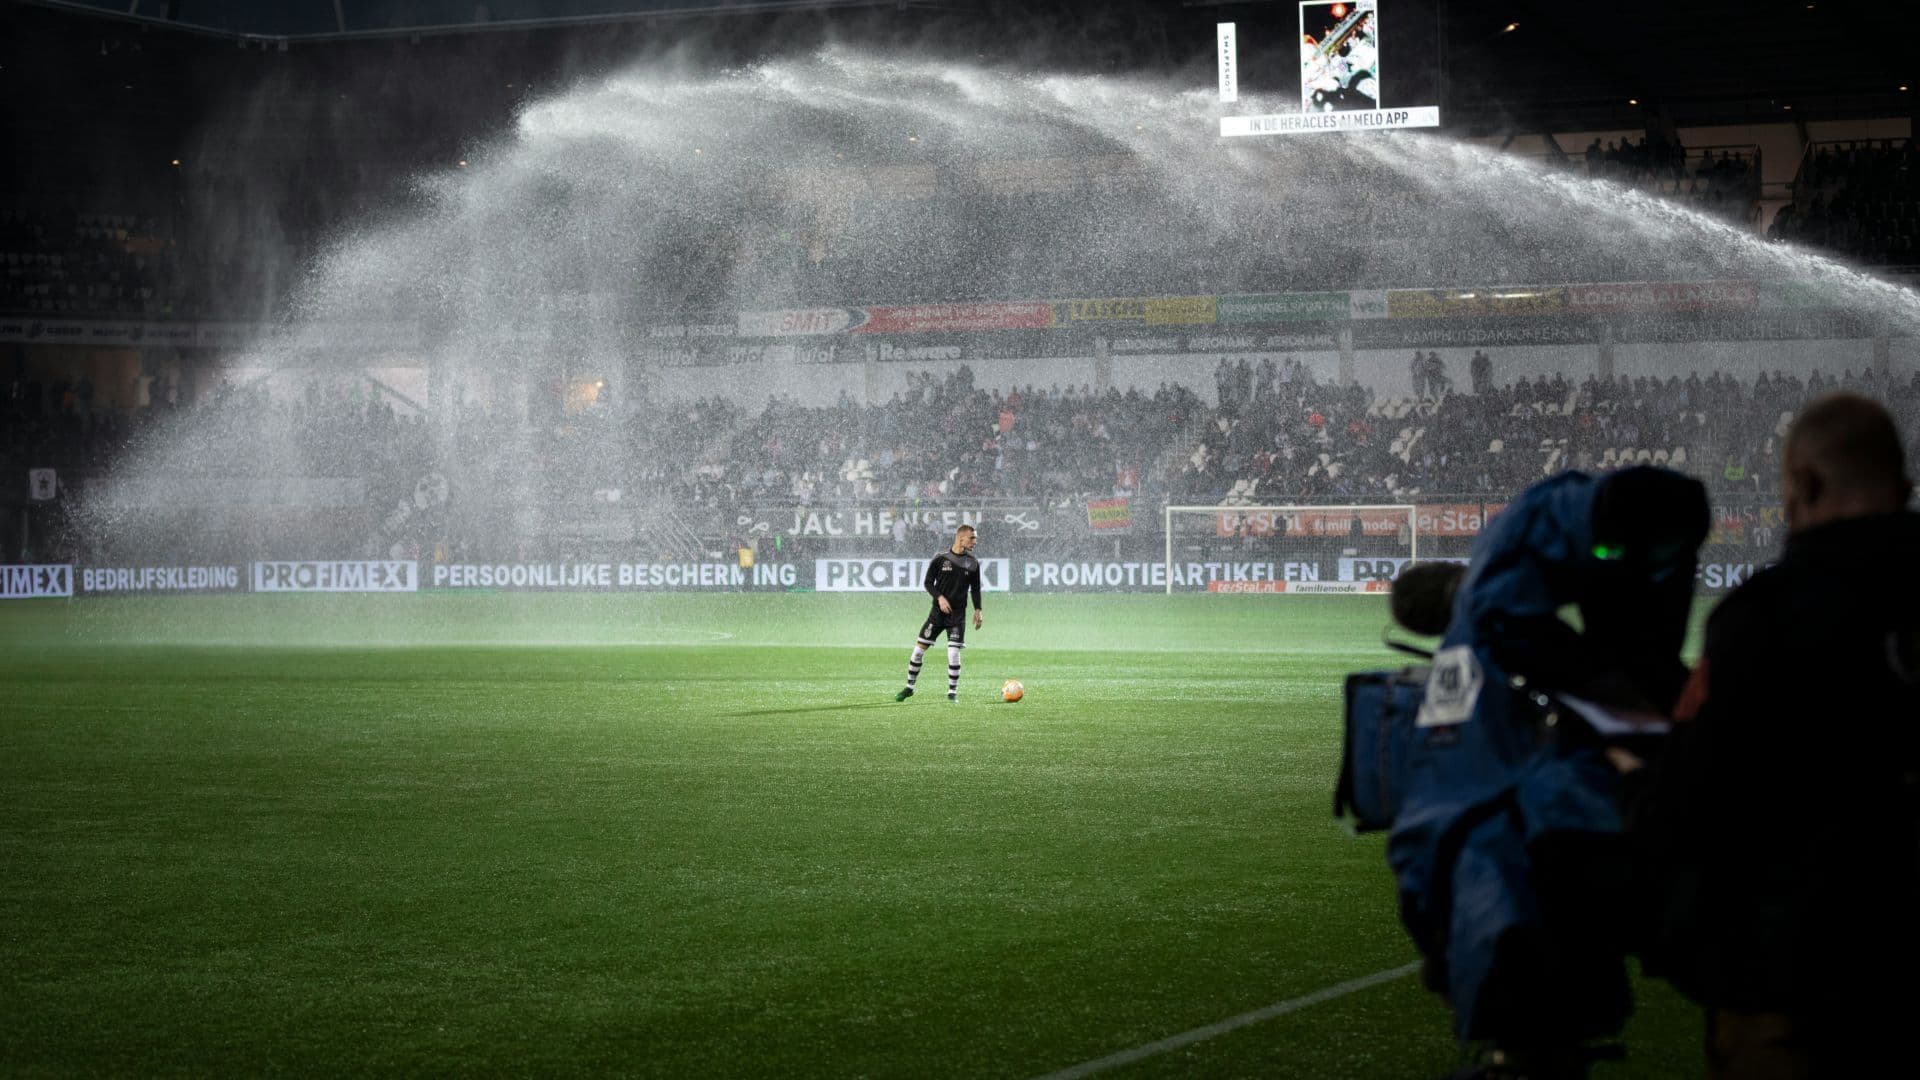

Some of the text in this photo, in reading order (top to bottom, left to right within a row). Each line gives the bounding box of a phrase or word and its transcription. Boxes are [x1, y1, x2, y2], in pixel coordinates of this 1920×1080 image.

[1250, 119, 1262, 131] IN
[1264, 118, 1277, 130] DE
[1280, 115, 1337, 130] HERACLES
[1385, 111, 1409, 125] APP
[786, 512, 843, 535] JAC
[82, 567, 238, 591] BEDRIJFSKLEDING
[261, 561, 411, 589] PROFIMEX
[433, 563, 611, 586] PERSOONLIJKE
